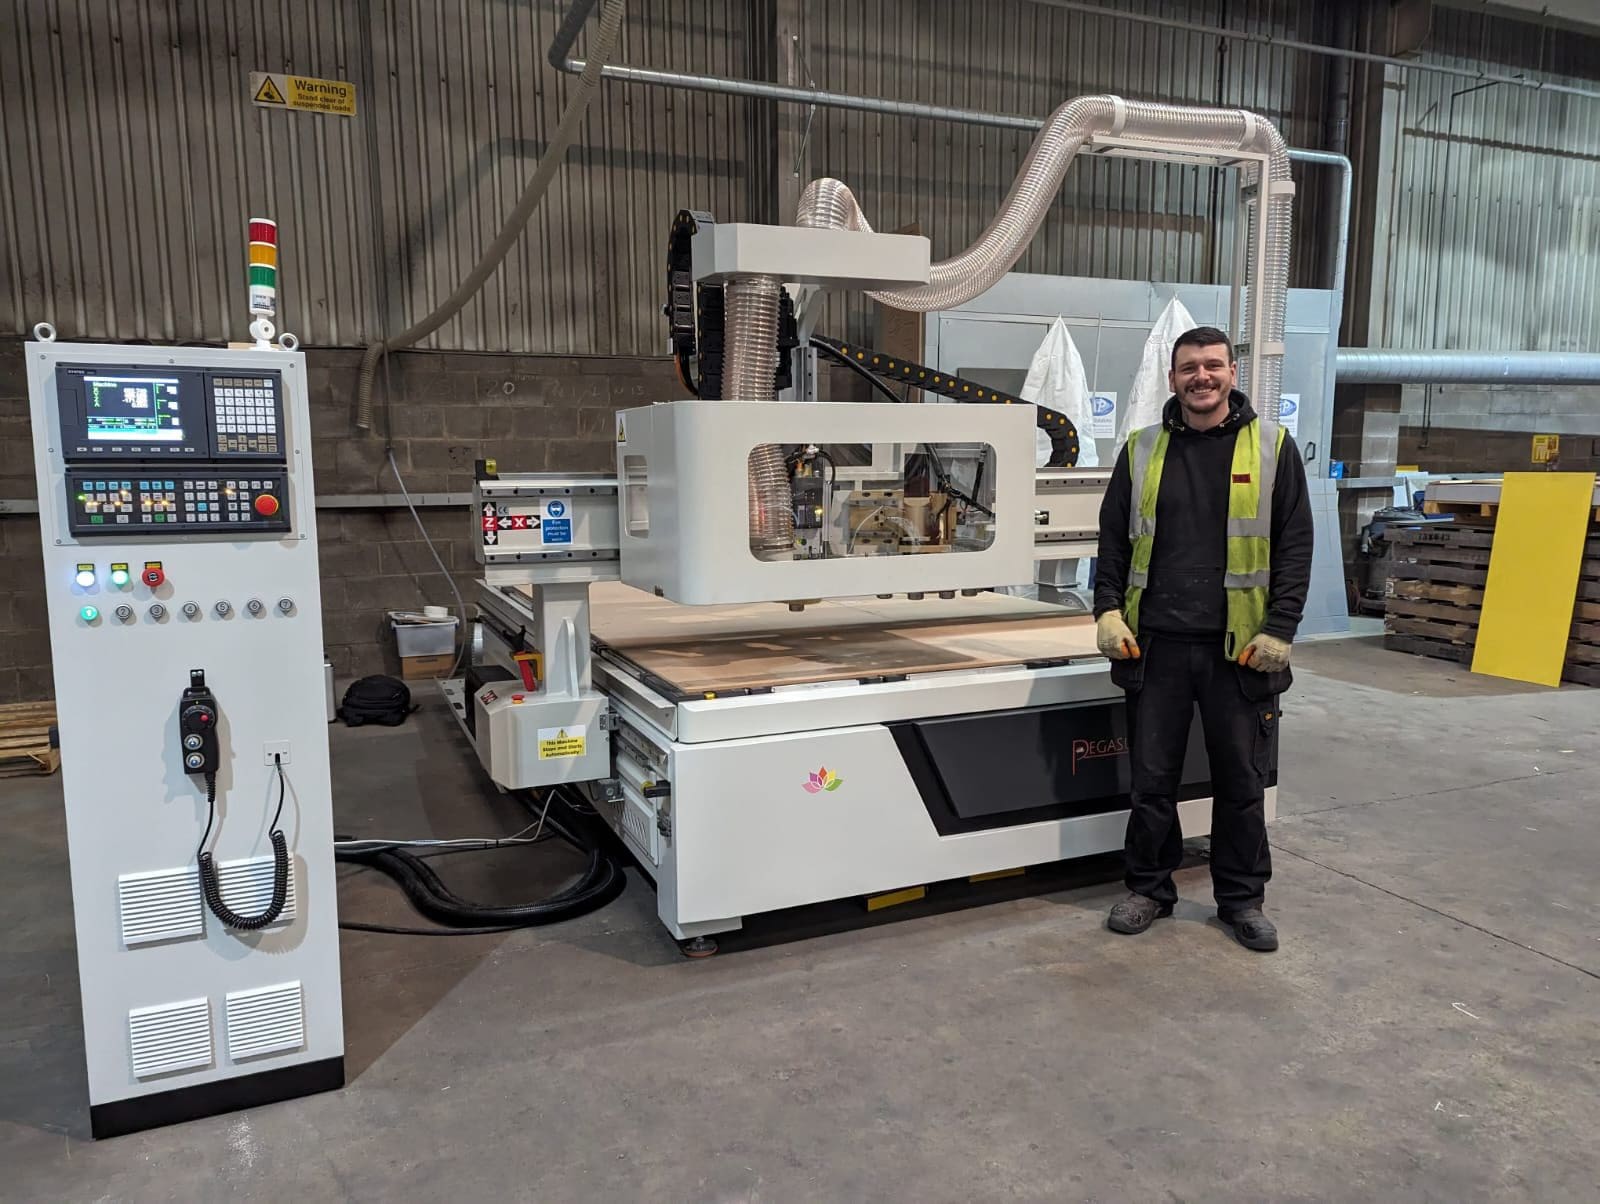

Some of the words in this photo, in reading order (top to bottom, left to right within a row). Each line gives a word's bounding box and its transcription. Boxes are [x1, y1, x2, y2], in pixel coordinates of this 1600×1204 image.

[294, 80, 346, 98] Warning
[297, 93, 318, 101] Stand
[485, 517, 495, 528] Z
[515, 518, 524, 528] X
